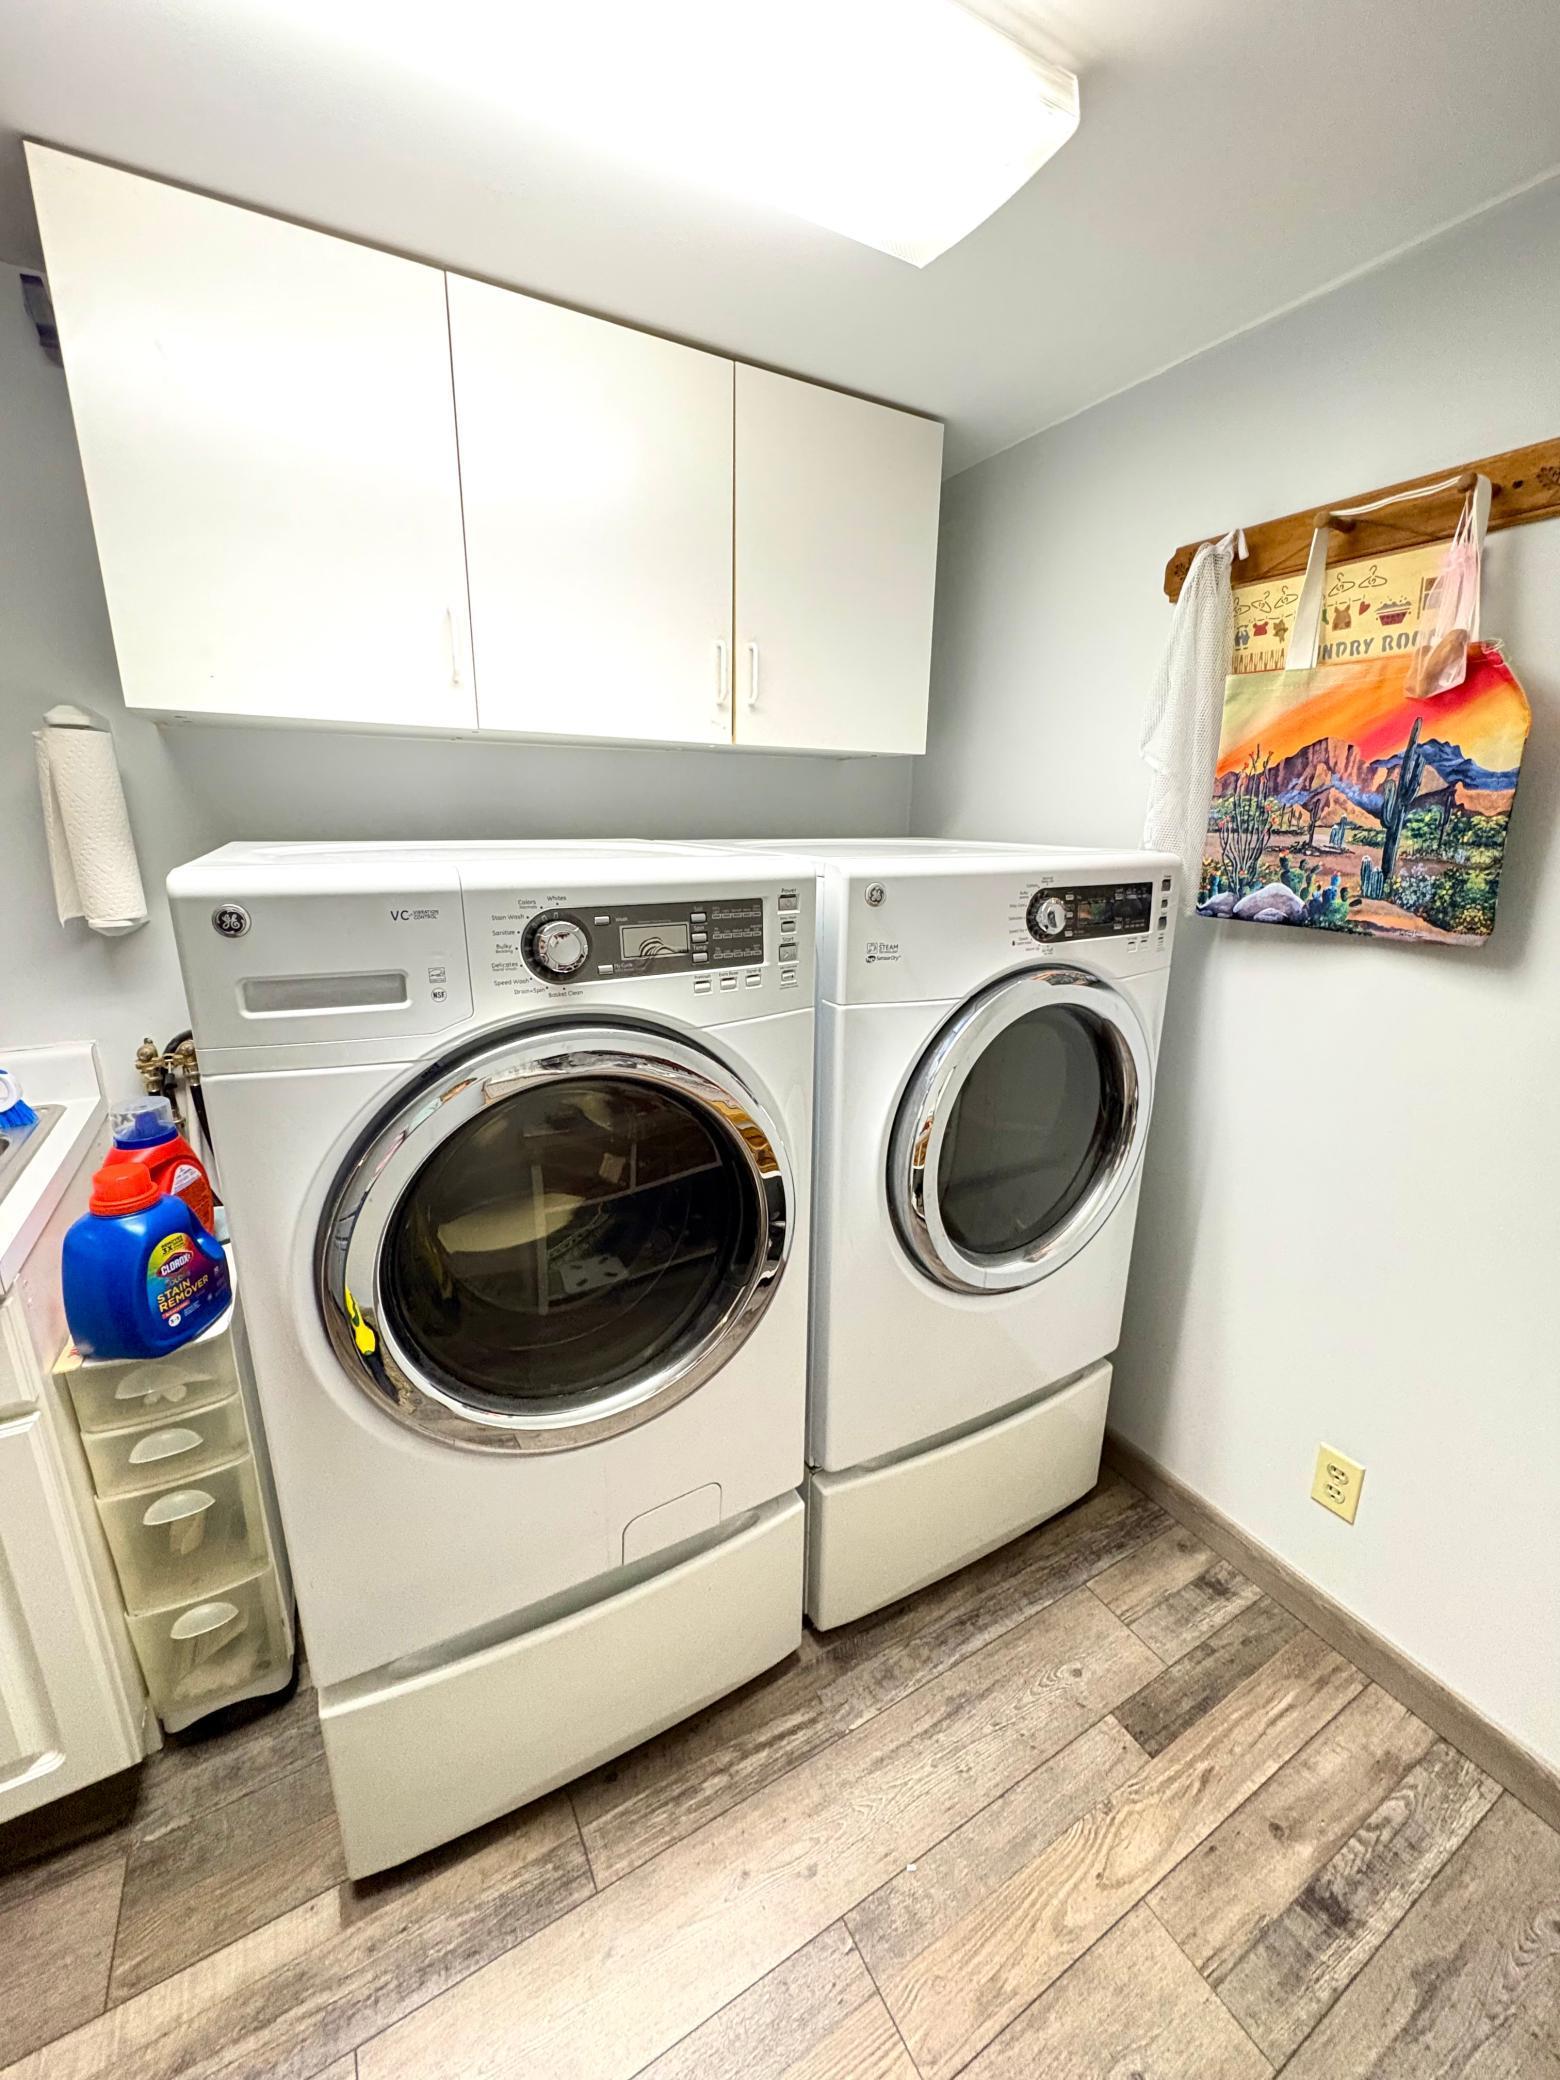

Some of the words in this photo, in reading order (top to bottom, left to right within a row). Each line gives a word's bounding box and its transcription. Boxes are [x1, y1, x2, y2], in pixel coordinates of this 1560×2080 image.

[1318, 637, 1375, 661] NDRY
[390, 910, 410, 921] VC
[433, 991, 445, 999] NSF
[157, 1278, 191, 1303] STAIN
[159, 1274, 209, 1312] REMOVER
